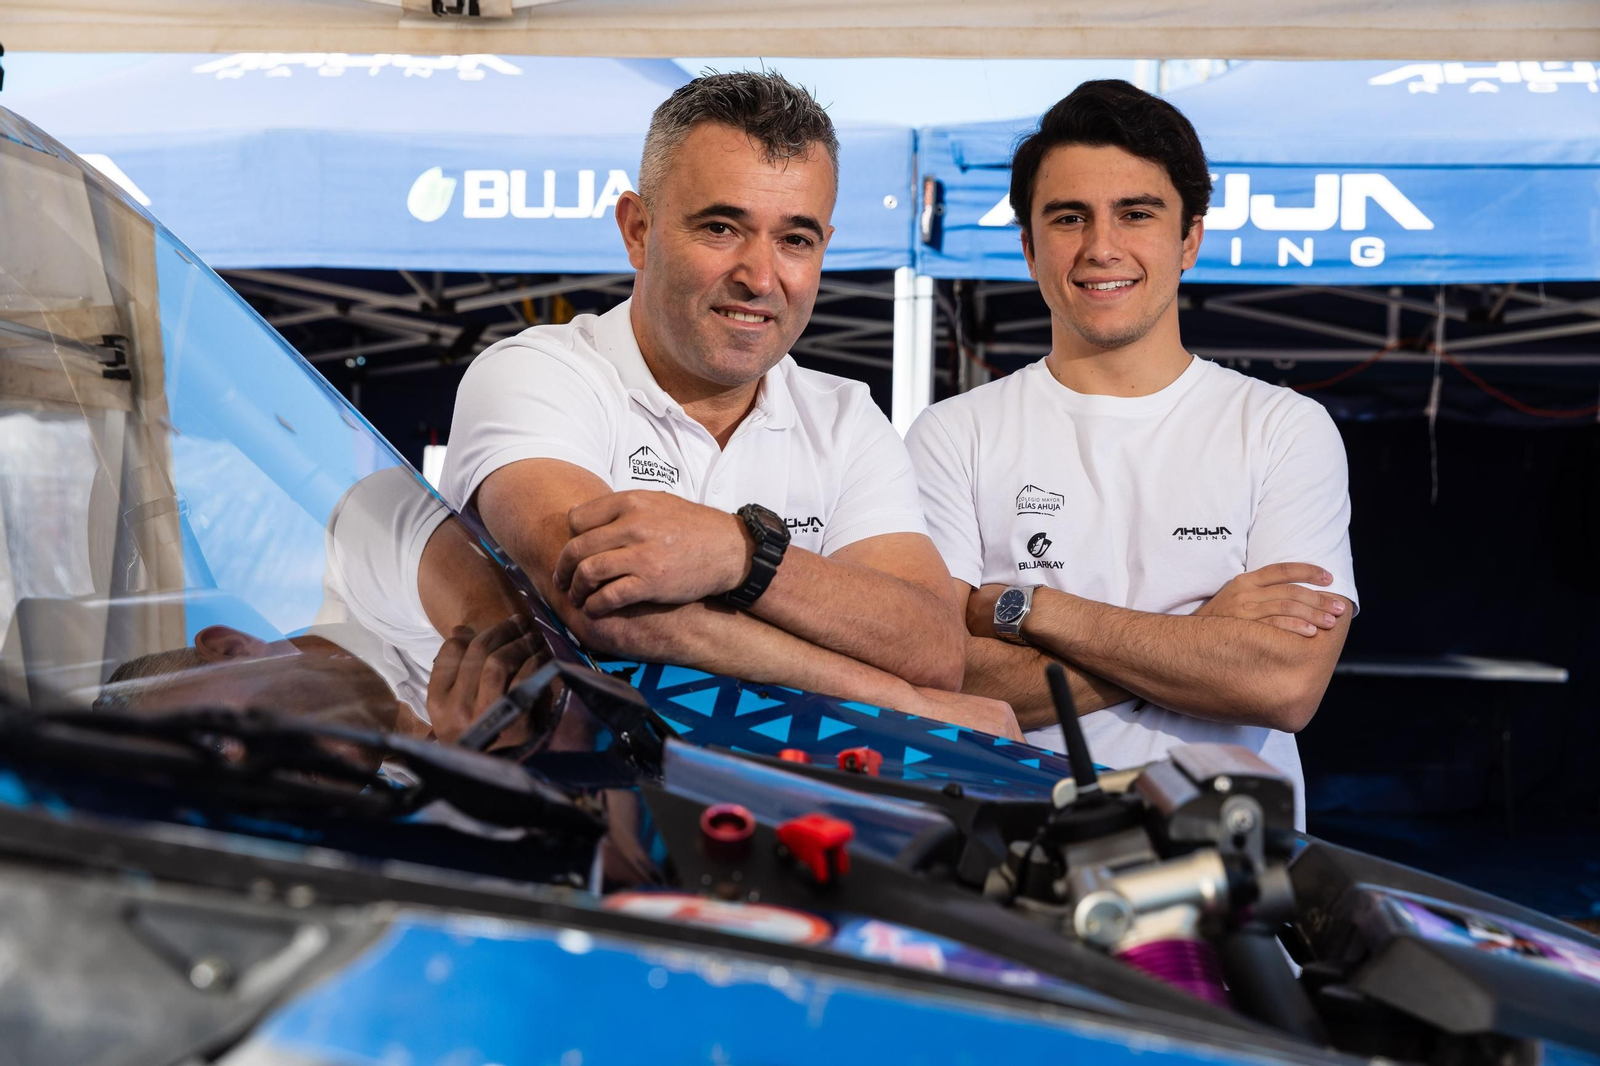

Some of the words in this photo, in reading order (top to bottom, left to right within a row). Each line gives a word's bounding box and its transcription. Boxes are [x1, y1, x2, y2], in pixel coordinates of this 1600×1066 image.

[1407, 79, 1599, 94] RACI
[463, 169, 638, 219] BUJA
[1230, 236, 1387, 268] ING
[631, 458, 659, 469] COLEGIO
[1037, 503, 1062, 512] AHUJA
[794, 526, 820, 535] ING
[1018, 560, 1065, 571] BUJARKAY
